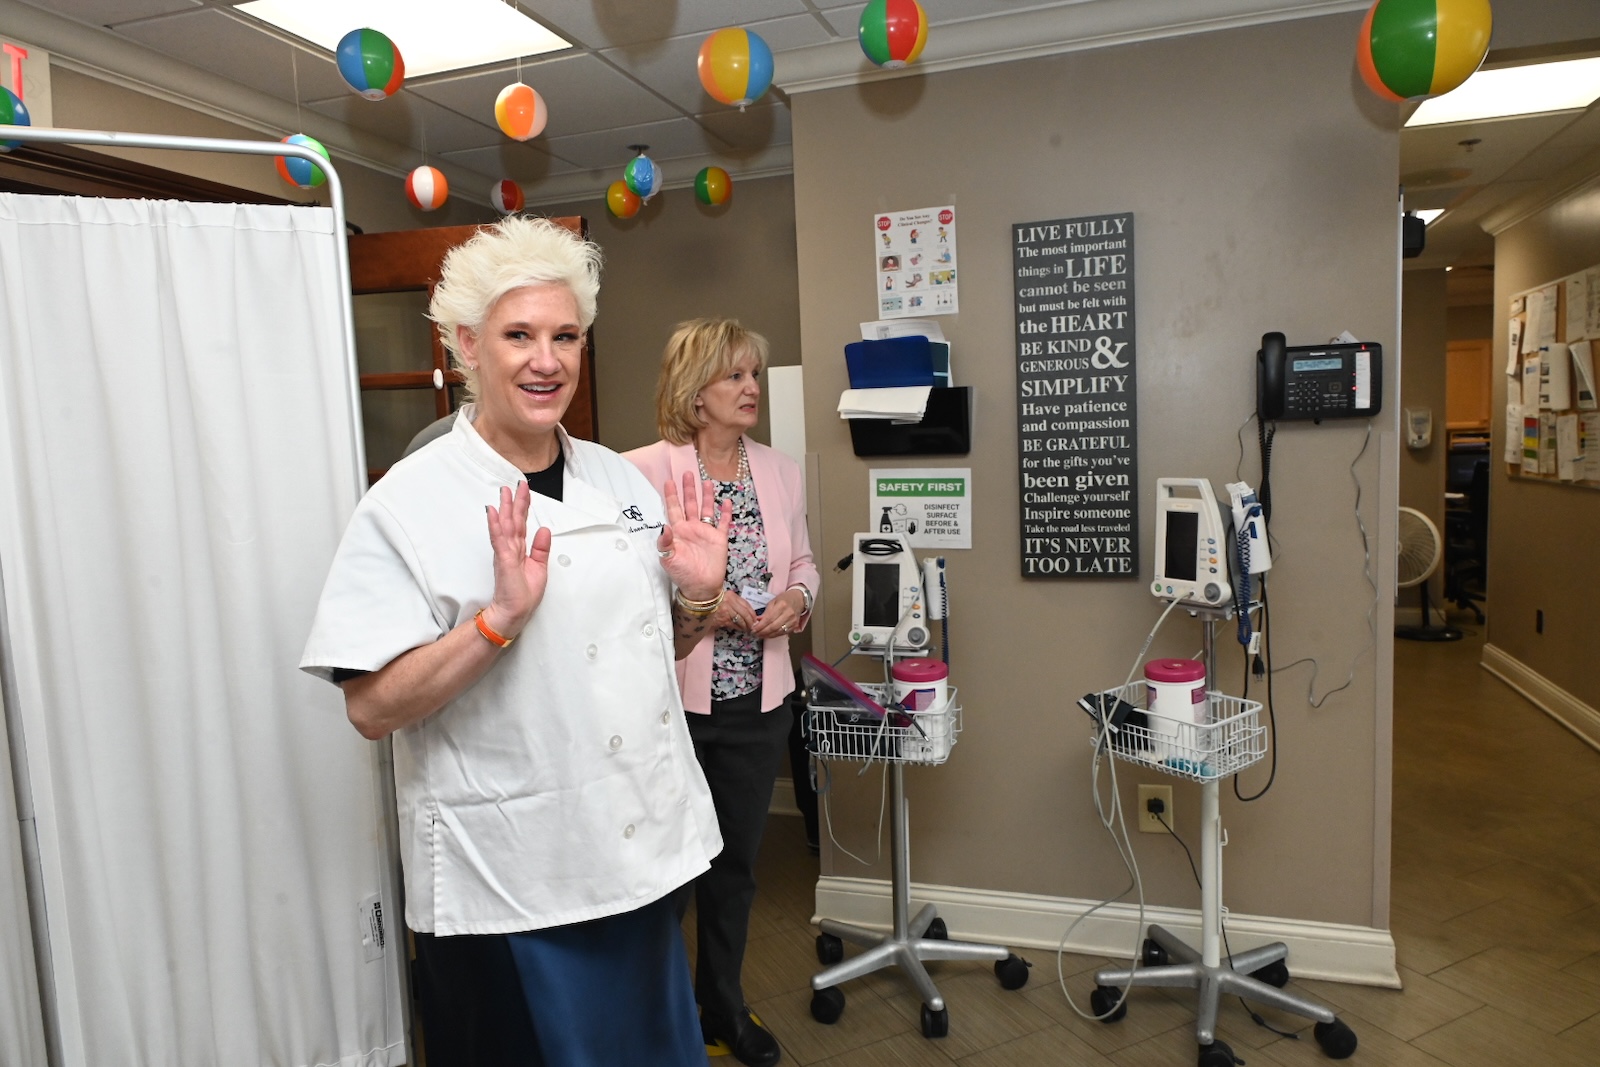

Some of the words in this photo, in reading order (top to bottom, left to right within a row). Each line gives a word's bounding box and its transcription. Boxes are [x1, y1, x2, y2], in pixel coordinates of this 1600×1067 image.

[1018, 225, 1061, 244] LIVE
[1065, 218, 1127, 239] FULLY
[1018, 247, 1038, 258] The
[1042, 244, 1067, 256] most
[1070, 238, 1127, 254] important
[1018, 266, 1051, 278] things
[1053, 264, 1064, 274] in
[1065, 254, 1127, 279] LIFE
[1019, 283, 1069, 298] cannot
[1073, 281, 1090, 293] be
[1094, 280, 1126, 292] seen
[1019, 304, 1036, 313] but
[1039, 301, 1064, 311] must
[1068, 300, 1080, 309] be
[1082, 298, 1100, 308] felt
[1103, 296, 1126, 306] with
[1020, 321, 1048, 334] the
[1051, 311, 1127, 333] HEART
[1021, 342, 1042, 356] BE
[1047, 339, 1091, 354] KIND
[1091, 336, 1129, 369] &
[1021, 358, 1089, 373] GENEROUS
[1022, 375, 1128, 397] SIMPLIFY
[1022, 403, 1060, 416] Have
[1064, 400, 1127, 416] patience
[1022, 420, 1047, 432] and
[1051, 417, 1130, 432] compassion
[1023, 439, 1042, 452] BE
[1046, 436, 1130, 451] GRATEFUL
[1023, 458, 1039, 468] for
[1043, 458, 1061, 468] the
[1063, 456, 1088, 469] gifts
[879, 483, 924, 491] SAFETY
[928, 483, 962, 491] FIRST
[1024, 473, 1069, 488] been
[1075, 471, 1129, 491] given
[1024, 493, 1080, 504] Challenge
[1082, 491, 1130, 504] yourself
[1025, 507, 1070, 522] Inspire
[1073, 509, 1131, 519] someone
[1025, 525, 1045, 533] Take
[1098, 524, 1130, 532] traveled
[1065, 537, 1131, 553] NEVER
[1025, 558, 1070, 573] TOO
[1076, 557, 1132, 573] LATE
